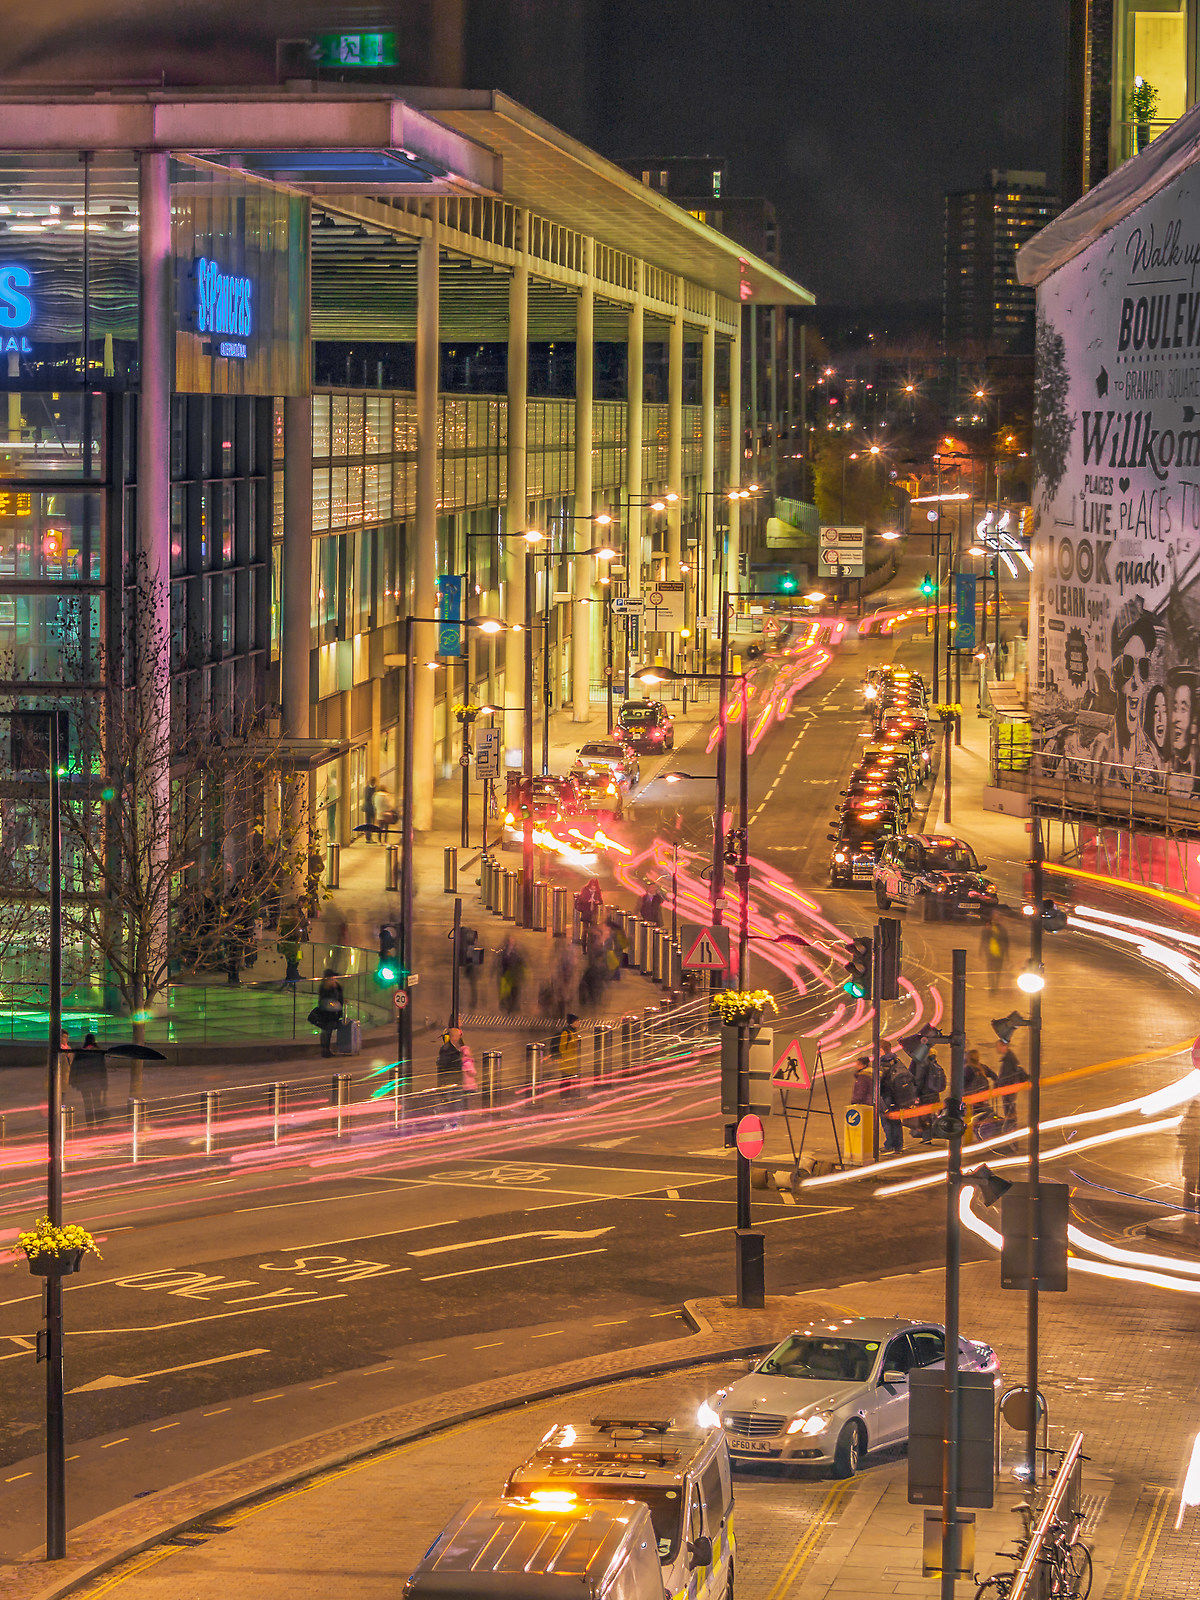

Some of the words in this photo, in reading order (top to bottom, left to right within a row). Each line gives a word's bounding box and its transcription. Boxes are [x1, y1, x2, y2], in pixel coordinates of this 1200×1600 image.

[1125, 219, 1183, 275] Walk
[1118, 292, 1200, 351] BOULEV
[1113, 381, 1124, 391] TO
[1082, 411, 1200, 480] Willkom
[1084, 474, 1114, 496] PLACES
[1120, 486, 1172, 542] PLACES
[1048, 535, 1112, 585] LOOK
[1055, 584, 1086, 618] LEARN
[395, 995, 406, 1003] 20
[115, 1271, 318, 1304] ONLY
[731, 1440, 750, 1449] GF60
[751, 1442, 766, 1450] KJK
